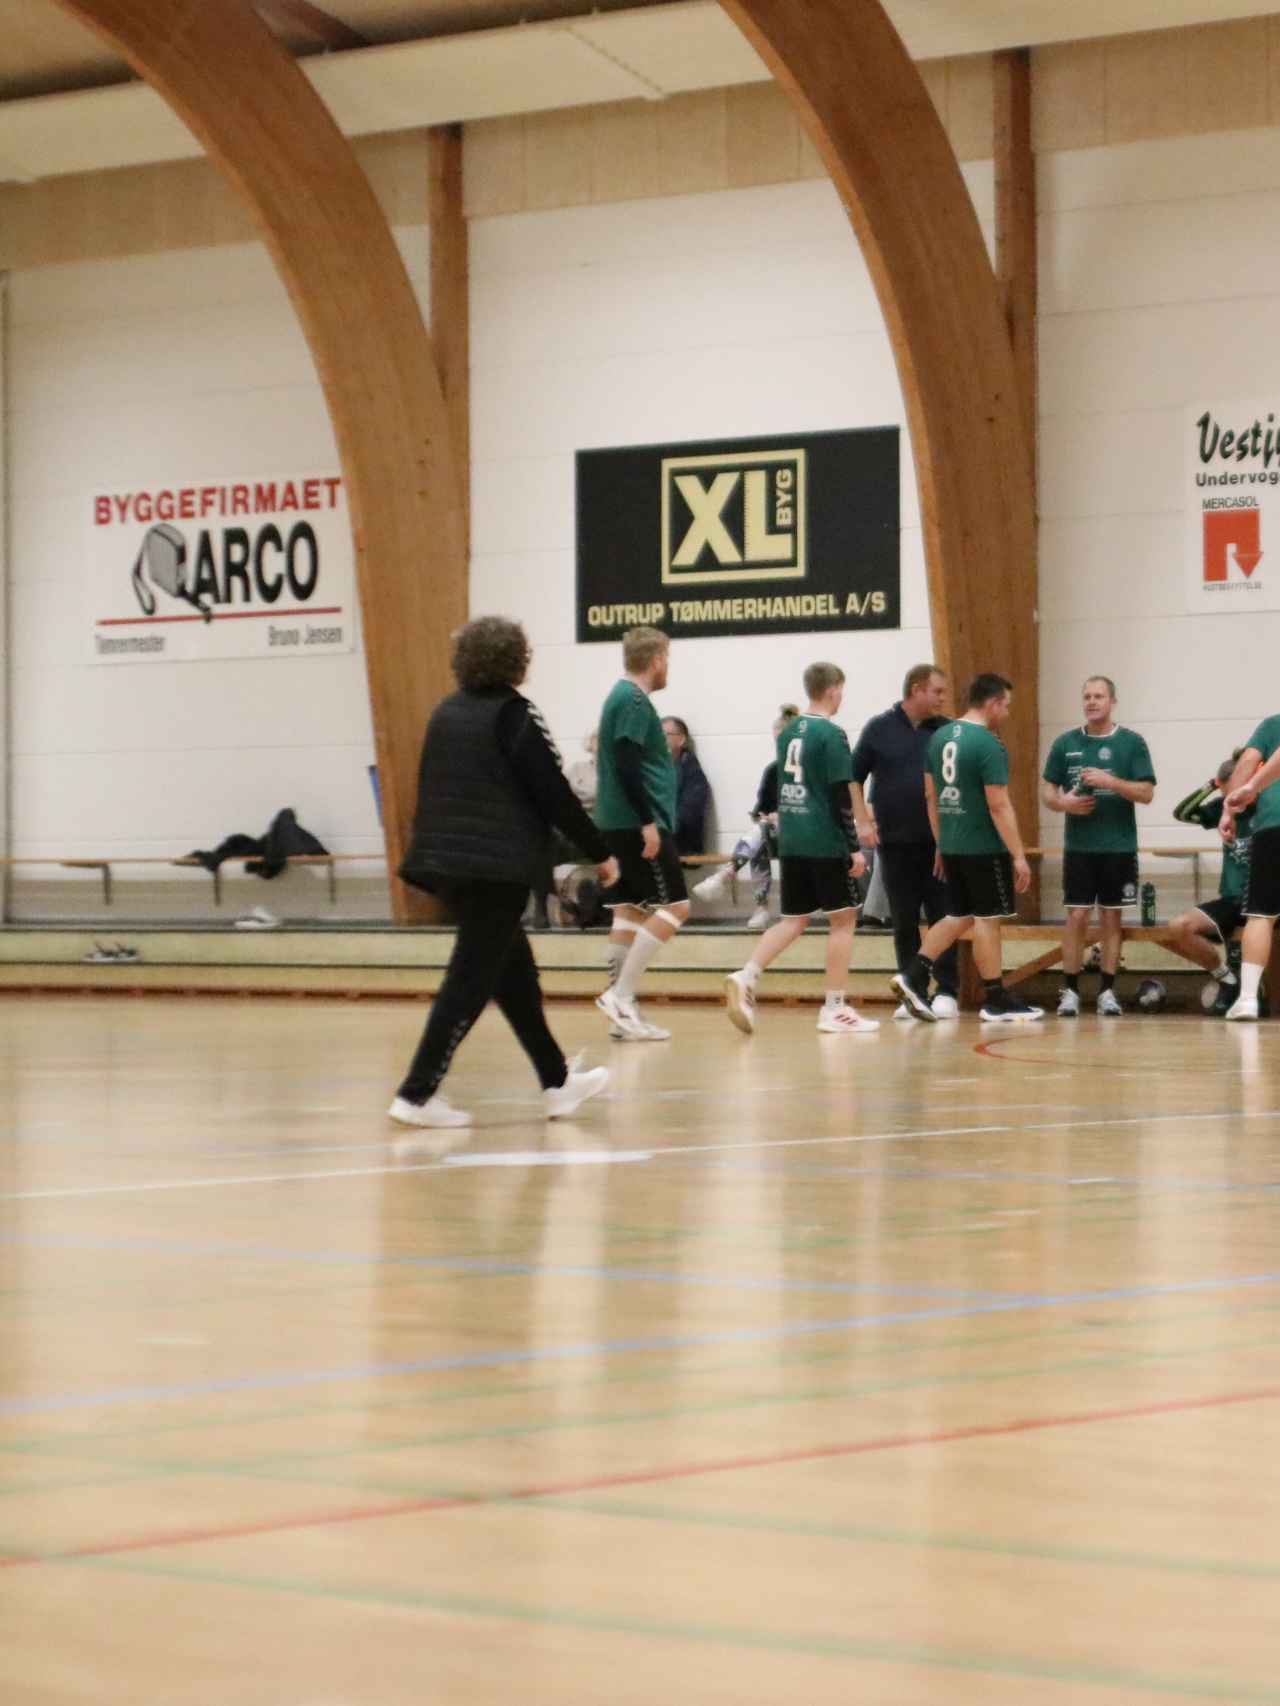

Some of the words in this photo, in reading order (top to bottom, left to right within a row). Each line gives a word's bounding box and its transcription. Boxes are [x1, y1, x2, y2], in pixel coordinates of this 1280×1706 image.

[94, 477, 341, 525] BYGGEFIRMAET
[671, 469, 793, 566] XL
[776, 467, 793, 526] BYG
[1202, 496, 1259, 509] MERCASOL
[192, 520, 318, 604] ARCO
[587, 602, 664, 626] OUTRUP
[669, 594, 839, 623] TØMMERHANDEL
[846, 591, 886, 616] A/S
[783, 738, 803, 783] 4
[942, 741, 957, 784] 8
